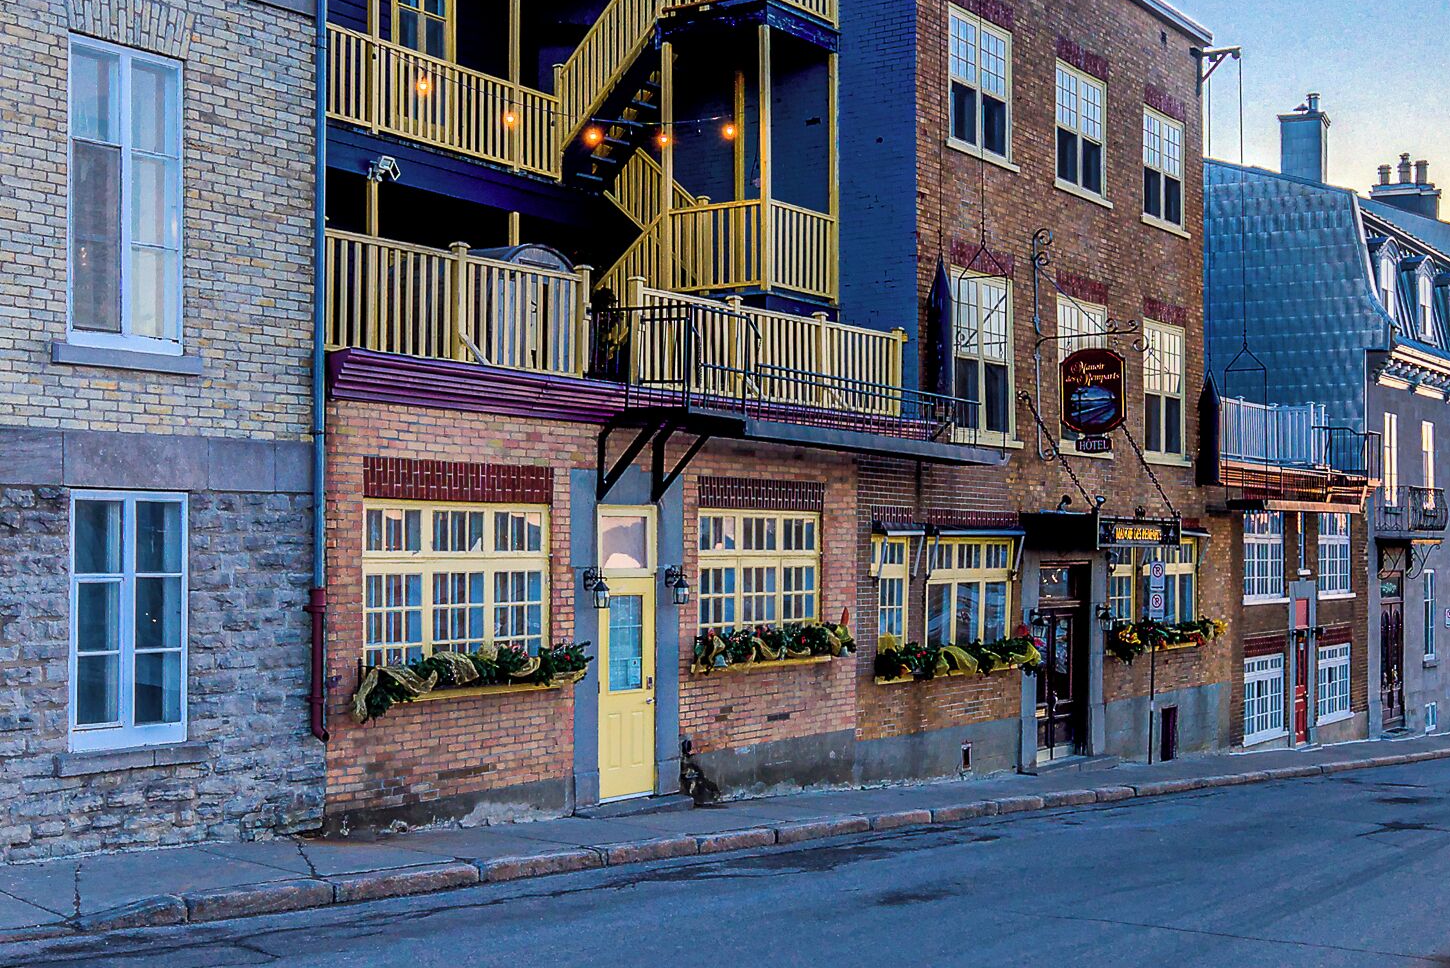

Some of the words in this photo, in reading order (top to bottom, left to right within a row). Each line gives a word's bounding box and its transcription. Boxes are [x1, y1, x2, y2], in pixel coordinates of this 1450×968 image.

[1070, 361, 1104, 374] Manoir
[1076, 372, 1120, 386] Remparts
[1079, 438, 1108, 450] HÔTEL
